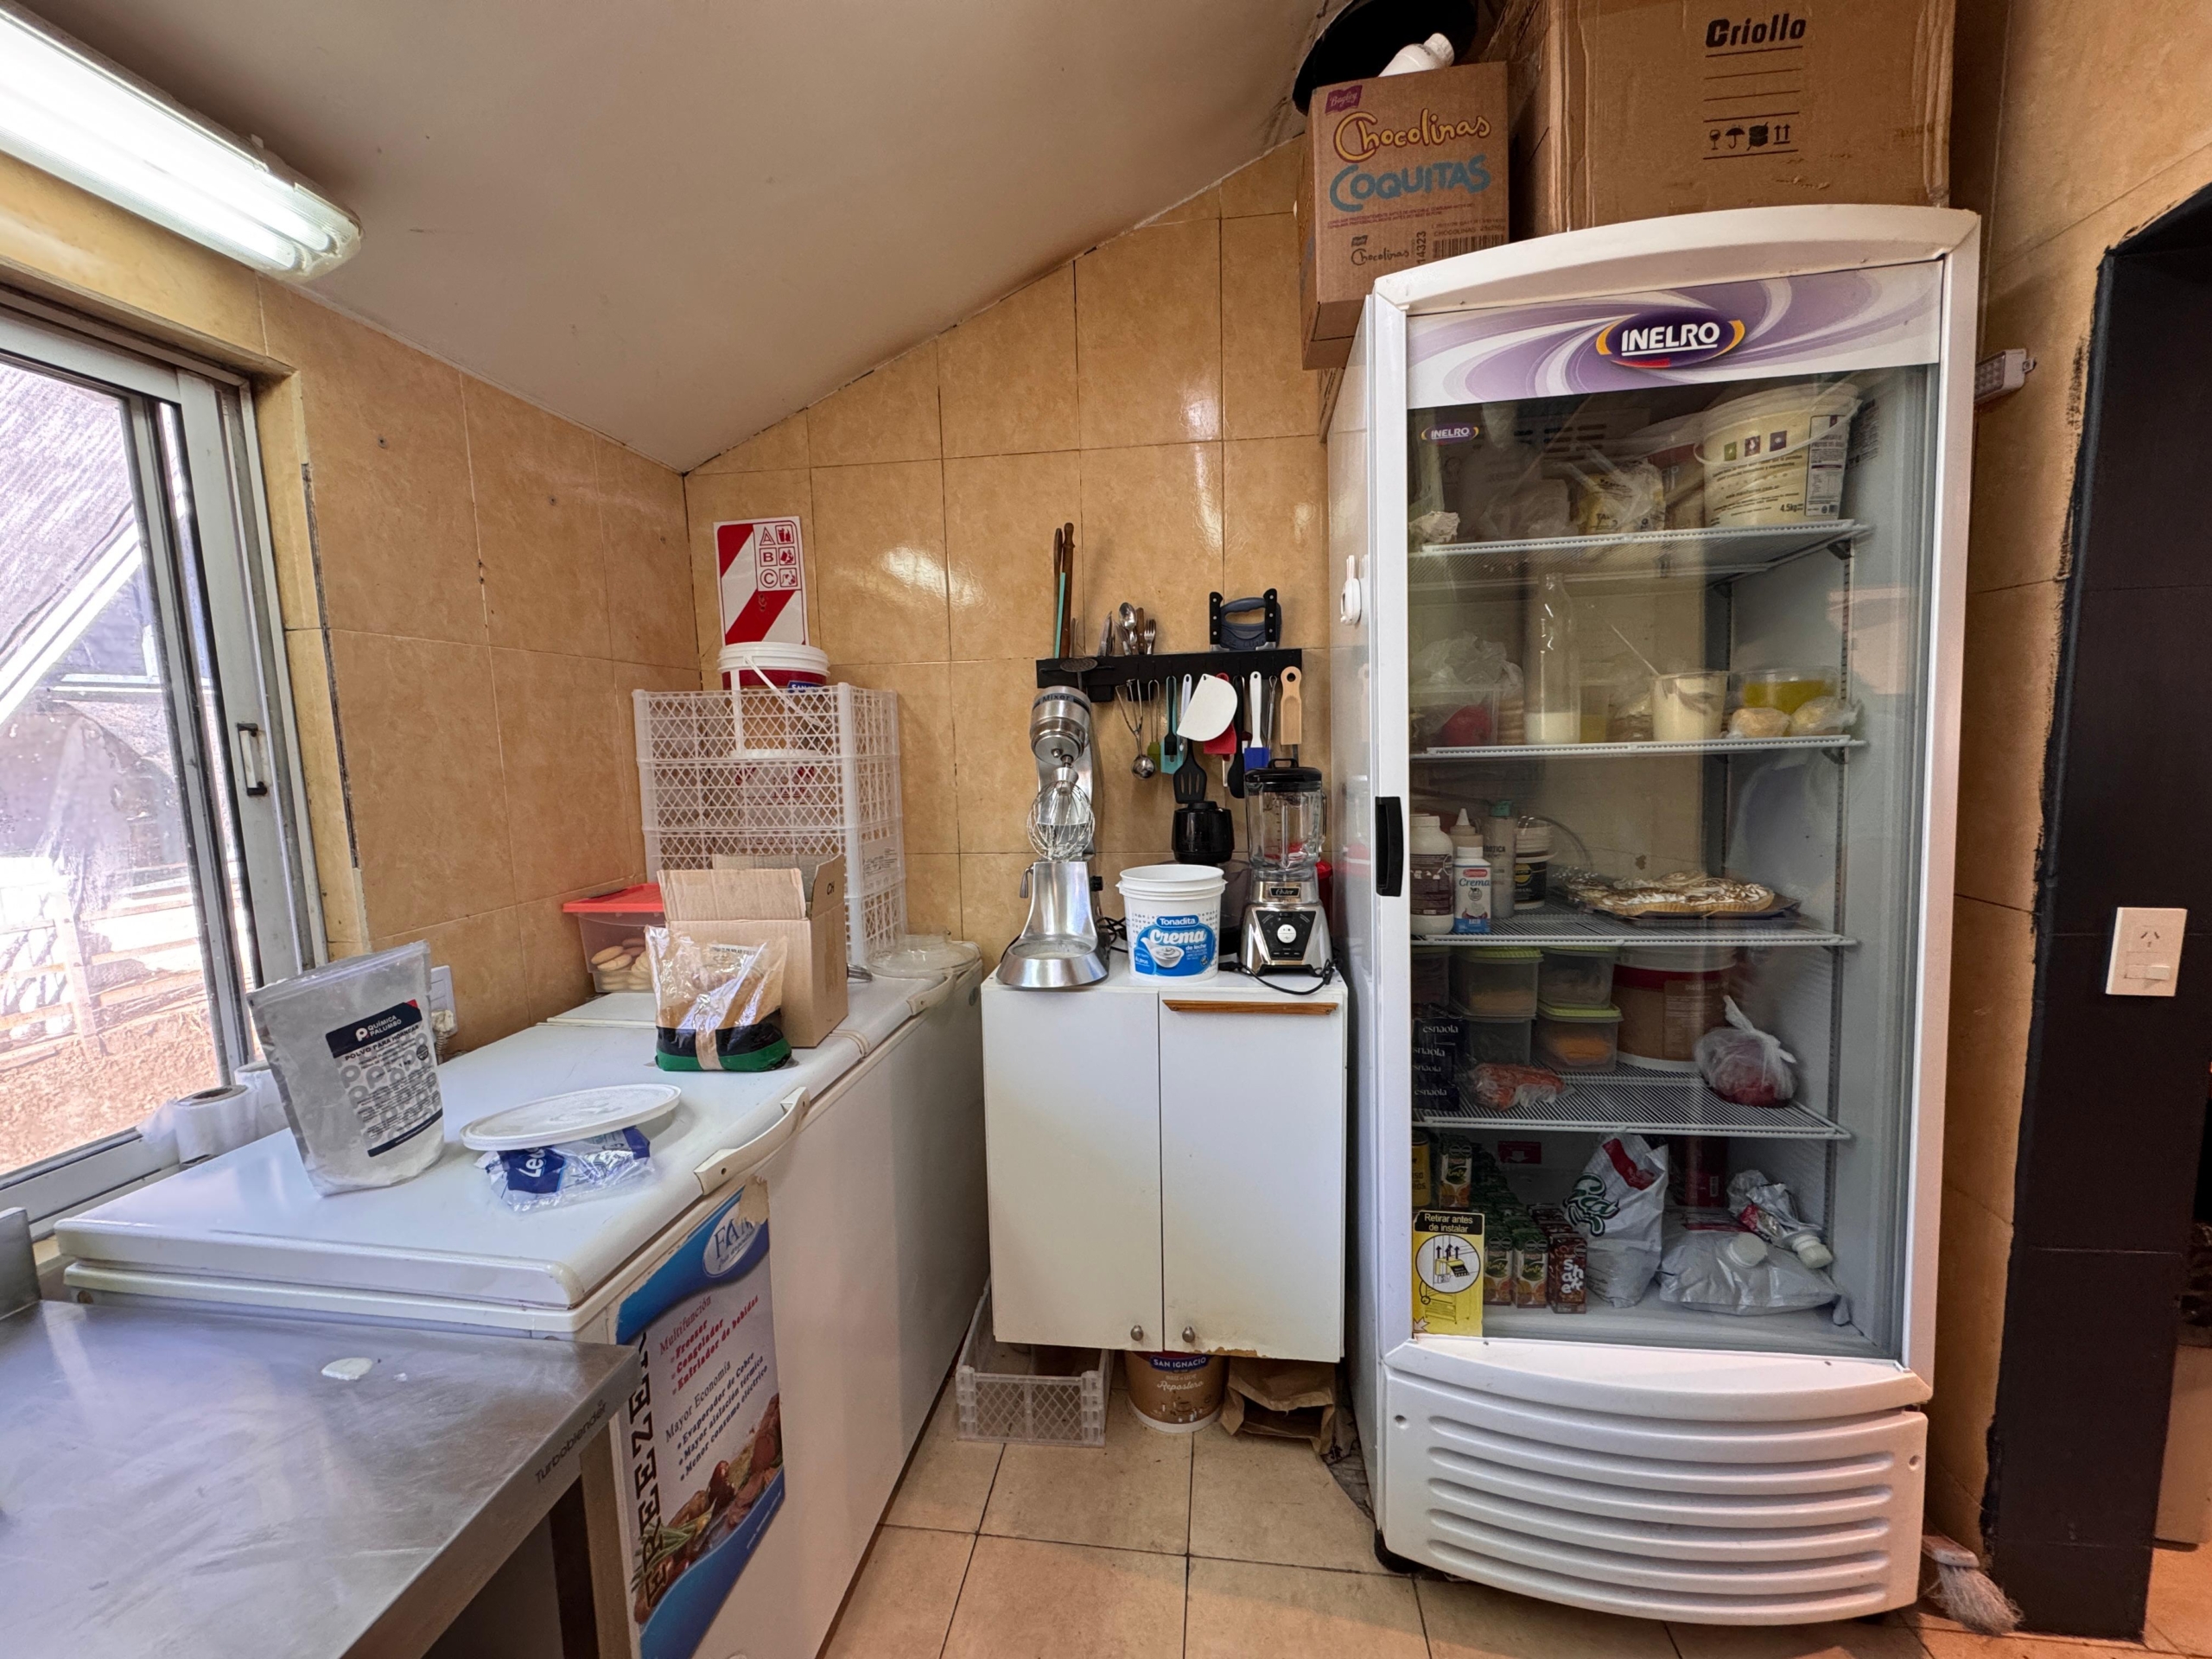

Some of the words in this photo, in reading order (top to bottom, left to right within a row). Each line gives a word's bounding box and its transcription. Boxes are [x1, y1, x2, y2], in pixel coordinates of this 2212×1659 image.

[1706, 13, 1806, 48] Criollo
[1333, 108, 1491, 163] Chocolinas
[1330, 154, 1491, 212] COQUITAS
[1434, 226, 1476, 237] CHOCOLINAS
[1351, 248, 1409, 265] Chocolinas
[1416, 231, 1427, 264] 14323
[1622, 322, 1720, 352] INELRO
[1431, 427, 1470, 439] INELRO
[763, 552, 774, 563] B
[764, 572, 775, 584] C
[1042, 694, 1070, 702] Mixer
[1459, 878, 1491, 887] Crema
[1160, 918, 1196, 926] Tonadita
[1149, 929, 1206, 944] Crema
[367, 1015, 397, 1031] QUÍMICA
[369, 1019, 402, 1037] PALUMBO
[345, 1047, 372, 1060] POLVO
[373, 1039, 391, 1050] PARA
[391, 1025, 419, 1041] HORNEAR
[1413, 1047, 1445, 1057] snaola
[1425, 1213, 1450, 1223] Retirar
[1440, 1224, 1469, 1233] instalar
[659, 1296, 711, 1356] Multifunción
[676, 1319, 707, 1359] Freezer
[677, 1339, 719, 1391] Enfriador
[721, 1328, 730, 1341] de
[732, 1295, 758, 1329] bebidas
[677, 1319, 723, 1374] Congelador
[1154, 1358, 1170, 1368] SAN
[1173, 1357, 1206, 1369] IGNACIO
[1157, 1380, 1204, 1392] Repostero
[665, 1404, 693, 1443] Mayor
[694, 1361, 731, 1409] Economía
[683, 1389, 726, 1445] Evaporador
[727, 1377, 735, 1390] de
[735, 1352, 754, 1378] Cobre
[683, 1427, 708, 1460] Mayor
[709, 1387, 740, 1429] aislación
[740, 1356, 763, 1389] térmica
[686, 1441, 709, 1476] Menor
[710, 1402, 741, 1443] consumo
[741, 1365, 767, 1403] eléctrico
[536, 1402, 607, 1484] Turboblender
